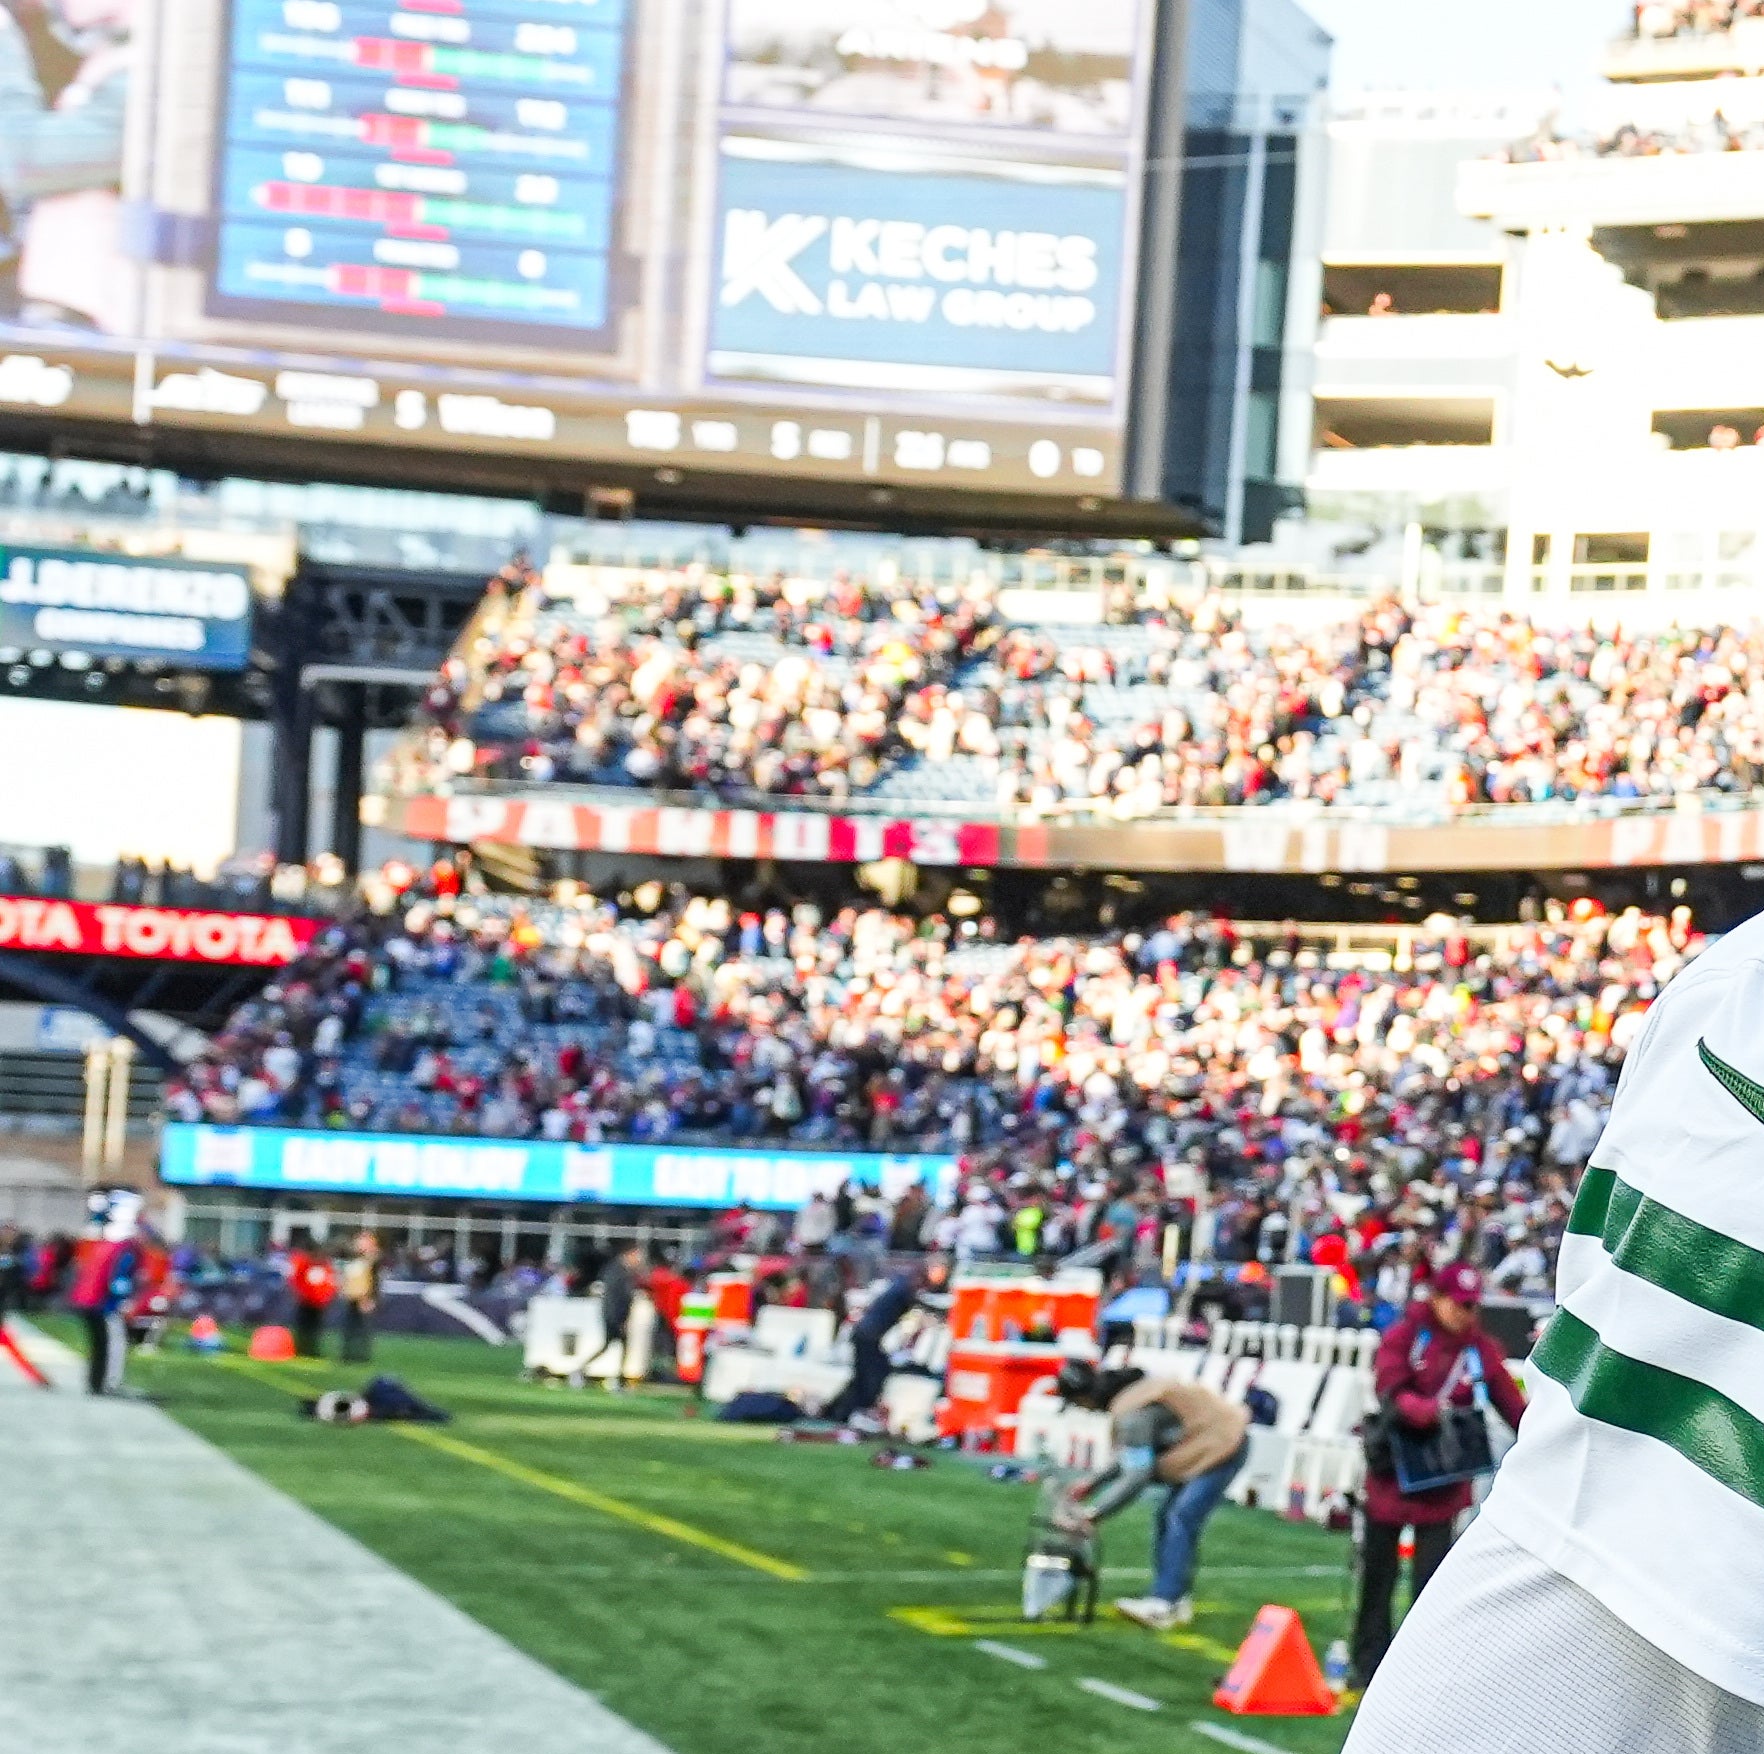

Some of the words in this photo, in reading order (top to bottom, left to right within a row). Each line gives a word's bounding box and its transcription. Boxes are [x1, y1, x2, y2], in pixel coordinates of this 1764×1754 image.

[831, 216, 1099, 292] KECHES
[828, 279, 937, 323] LAW
[942, 287, 1096, 334] GROUP
[445, 796, 960, 865] PATRIOTS
[1222, 822, 1388, 872] WIN
[95, 902, 297, 962] TOYOTA
